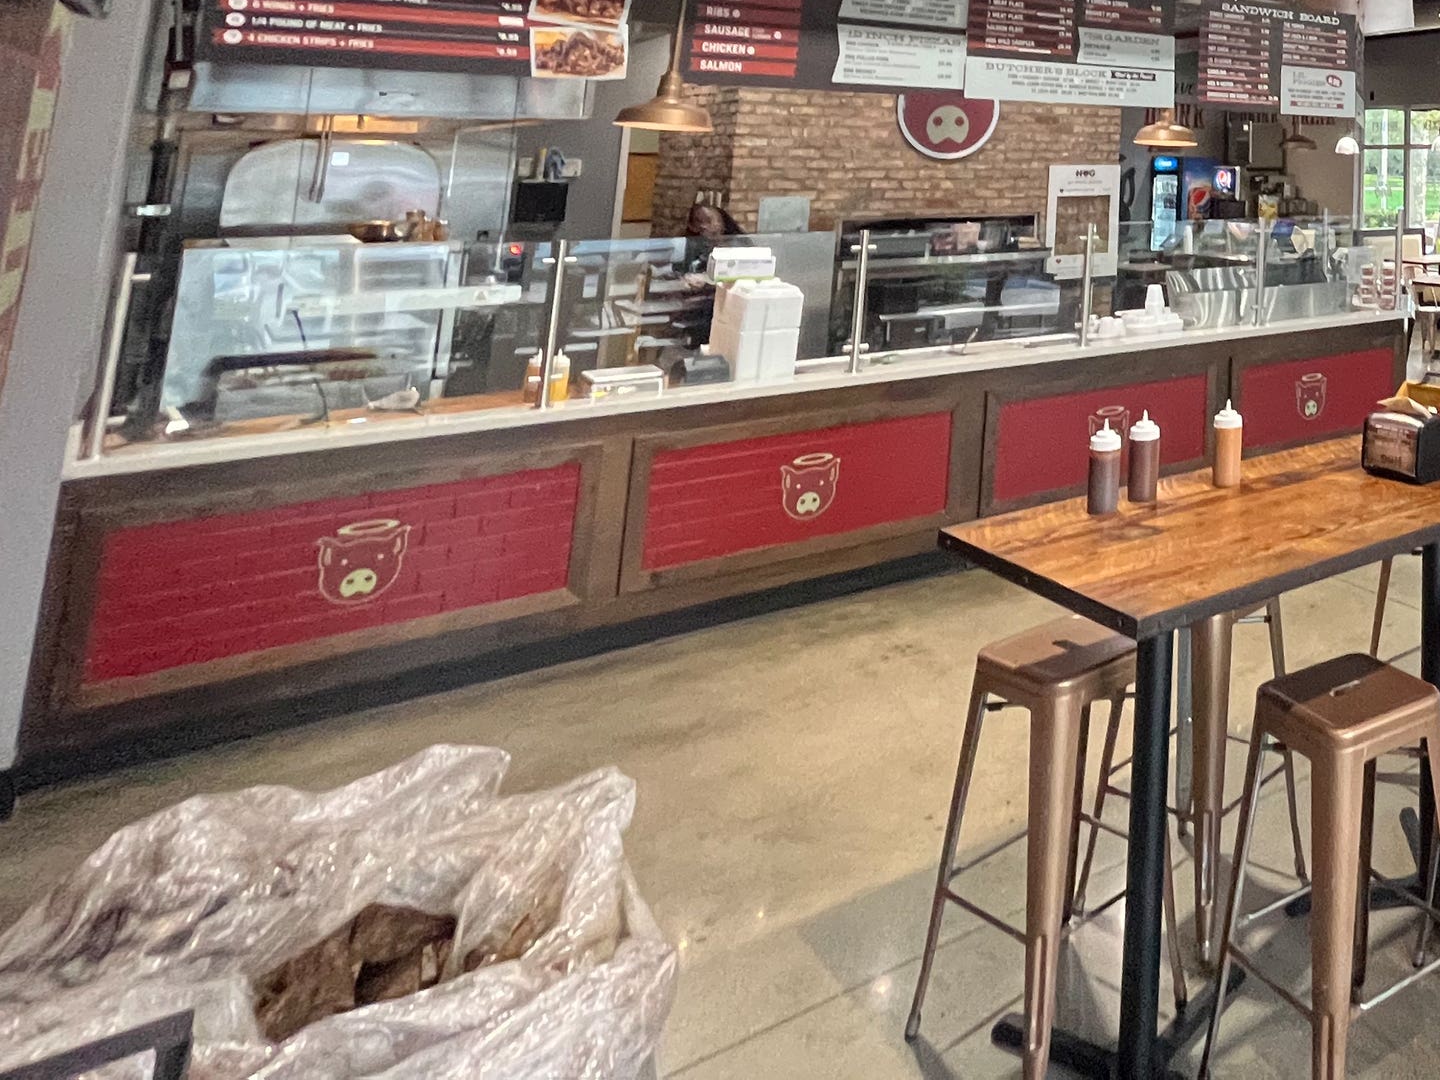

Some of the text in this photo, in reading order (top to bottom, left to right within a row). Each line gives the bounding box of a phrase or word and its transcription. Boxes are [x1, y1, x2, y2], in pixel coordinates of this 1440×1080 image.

[706, 6, 730, 18] RIBS
[1221, 2, 1341, 26] SANDWICH BOARD
[320, 20, 346, 30] MEAT
[704, 24, 750, 38] SAUSAGE
[257, 33, 301, 44] CHICKEN
[303, 35, 337, 46] STRIPS
[1104, 33, 1160, 46] GARDEN
[702, 41, 746, 55] CHICKEN
[700, 59, 742, 72] SALMON
[1065, 67, 1107, 78] BLOCK
